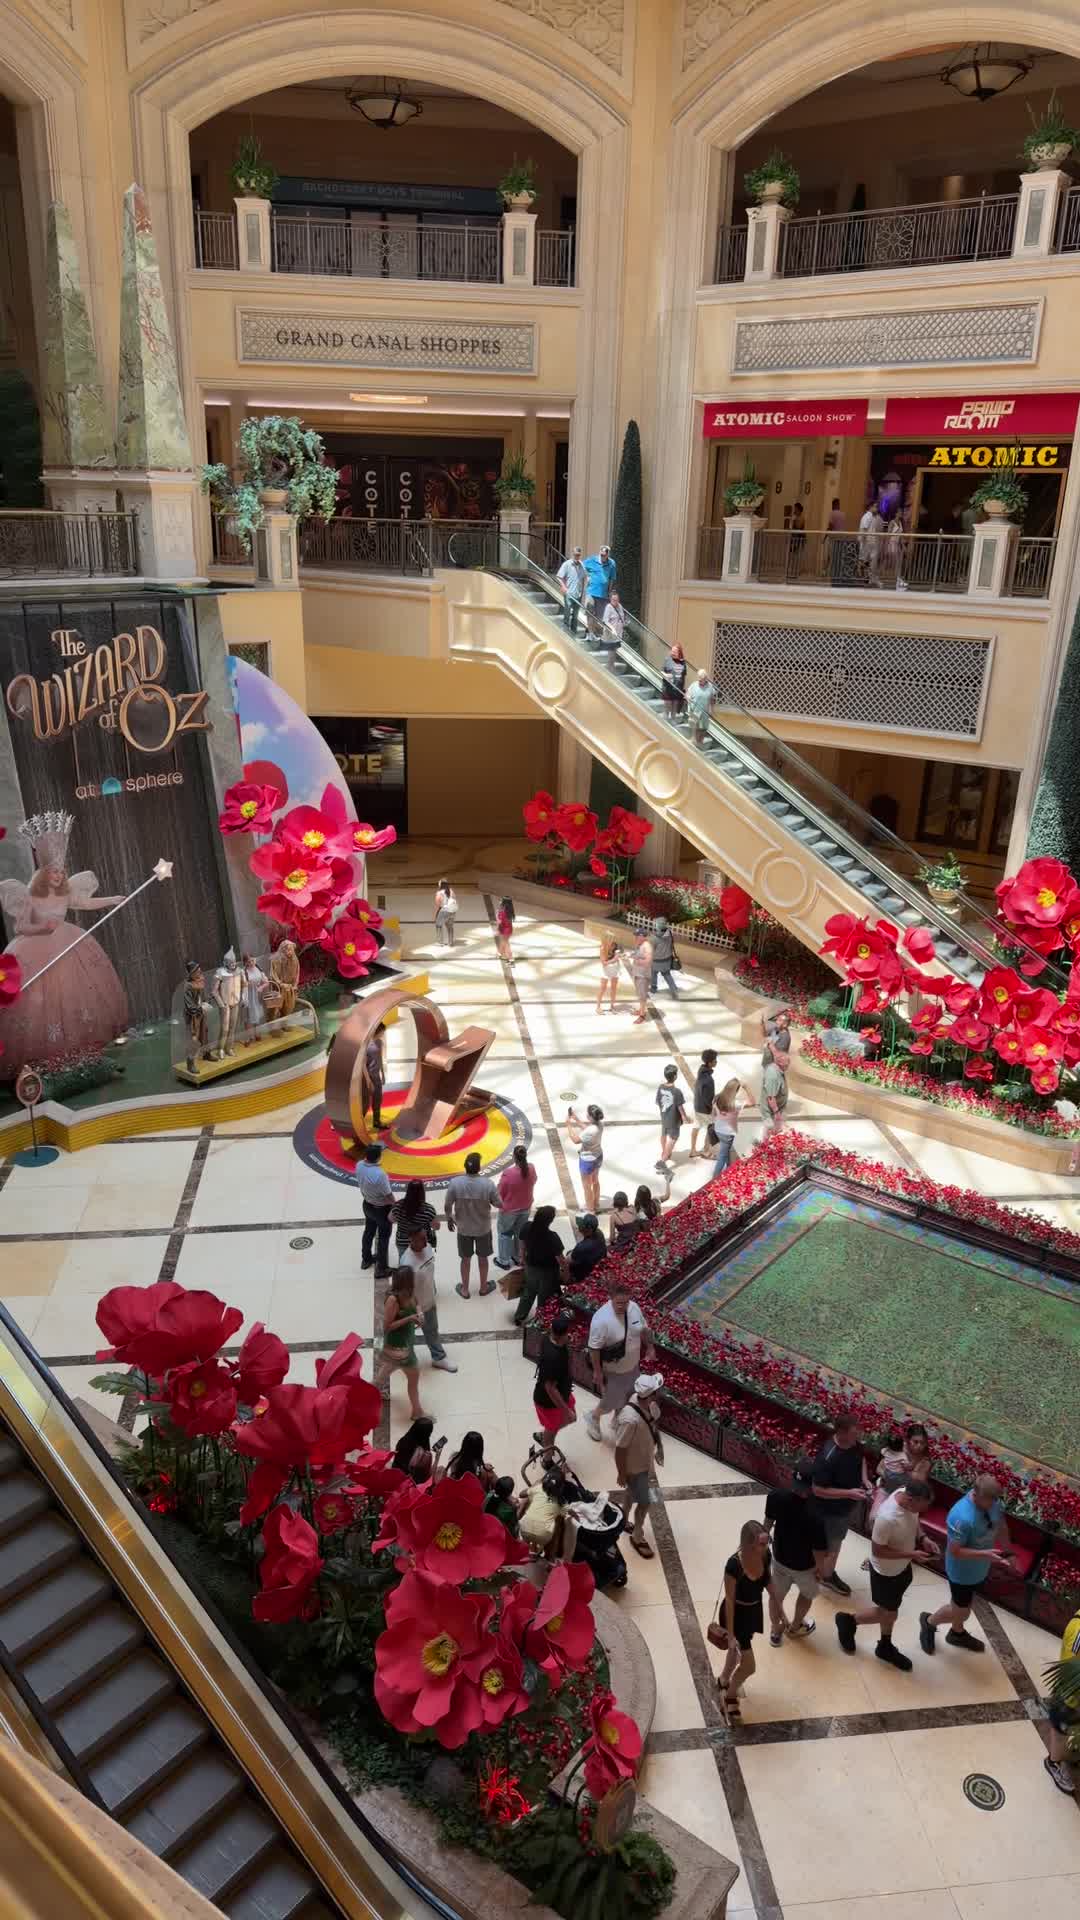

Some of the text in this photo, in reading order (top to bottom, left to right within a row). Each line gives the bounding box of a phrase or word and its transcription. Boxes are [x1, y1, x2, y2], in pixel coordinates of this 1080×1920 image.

[276, 329, 501, 355] GRAND CANAL SHOPPES
[713, 412, 853, 426] ATOMIC SALOON SHOW
[944, 414, 1000, 430] ROOM
[929, 446, 1058, 467] ATOMIC
[365, 471, 378, 534] COTE
[51, 629, 86, 655] The
[7, 625, 164, 740] WIZARD
[98, 699, 118, 729] of
[335, 754, 383, 773] OTE
[75, 773, 183, 799] at sphere
